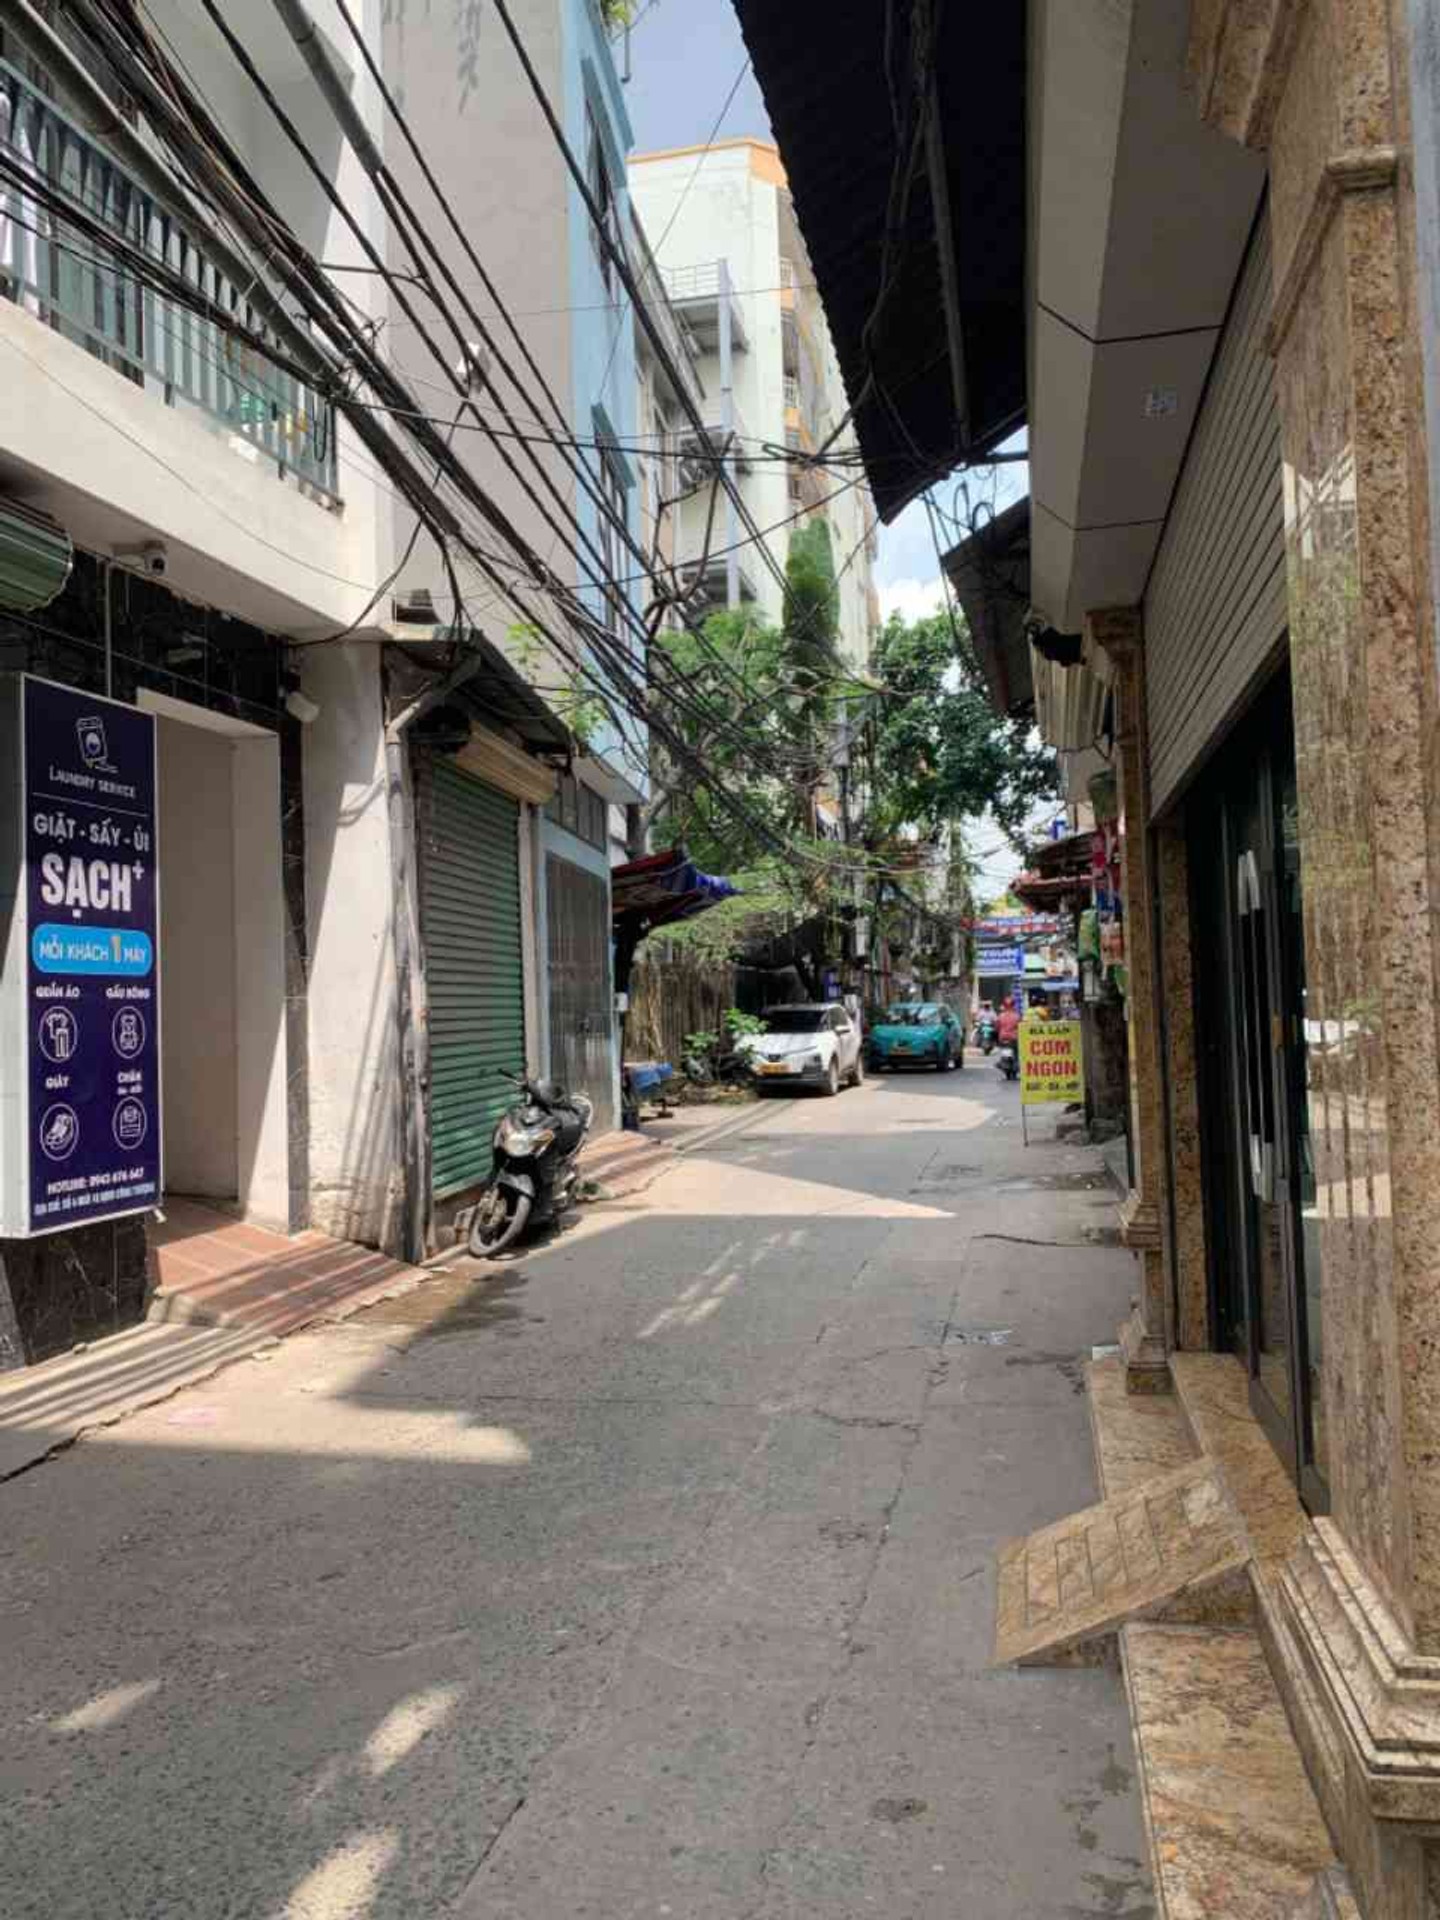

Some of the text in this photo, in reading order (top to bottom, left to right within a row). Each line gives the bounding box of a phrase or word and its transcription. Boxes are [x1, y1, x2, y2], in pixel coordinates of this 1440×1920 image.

[89, 817, 121, 847] SẤY
[133, 825, 150, 852] ỦI
[1026, 1060, 1077, 1077] NGON
